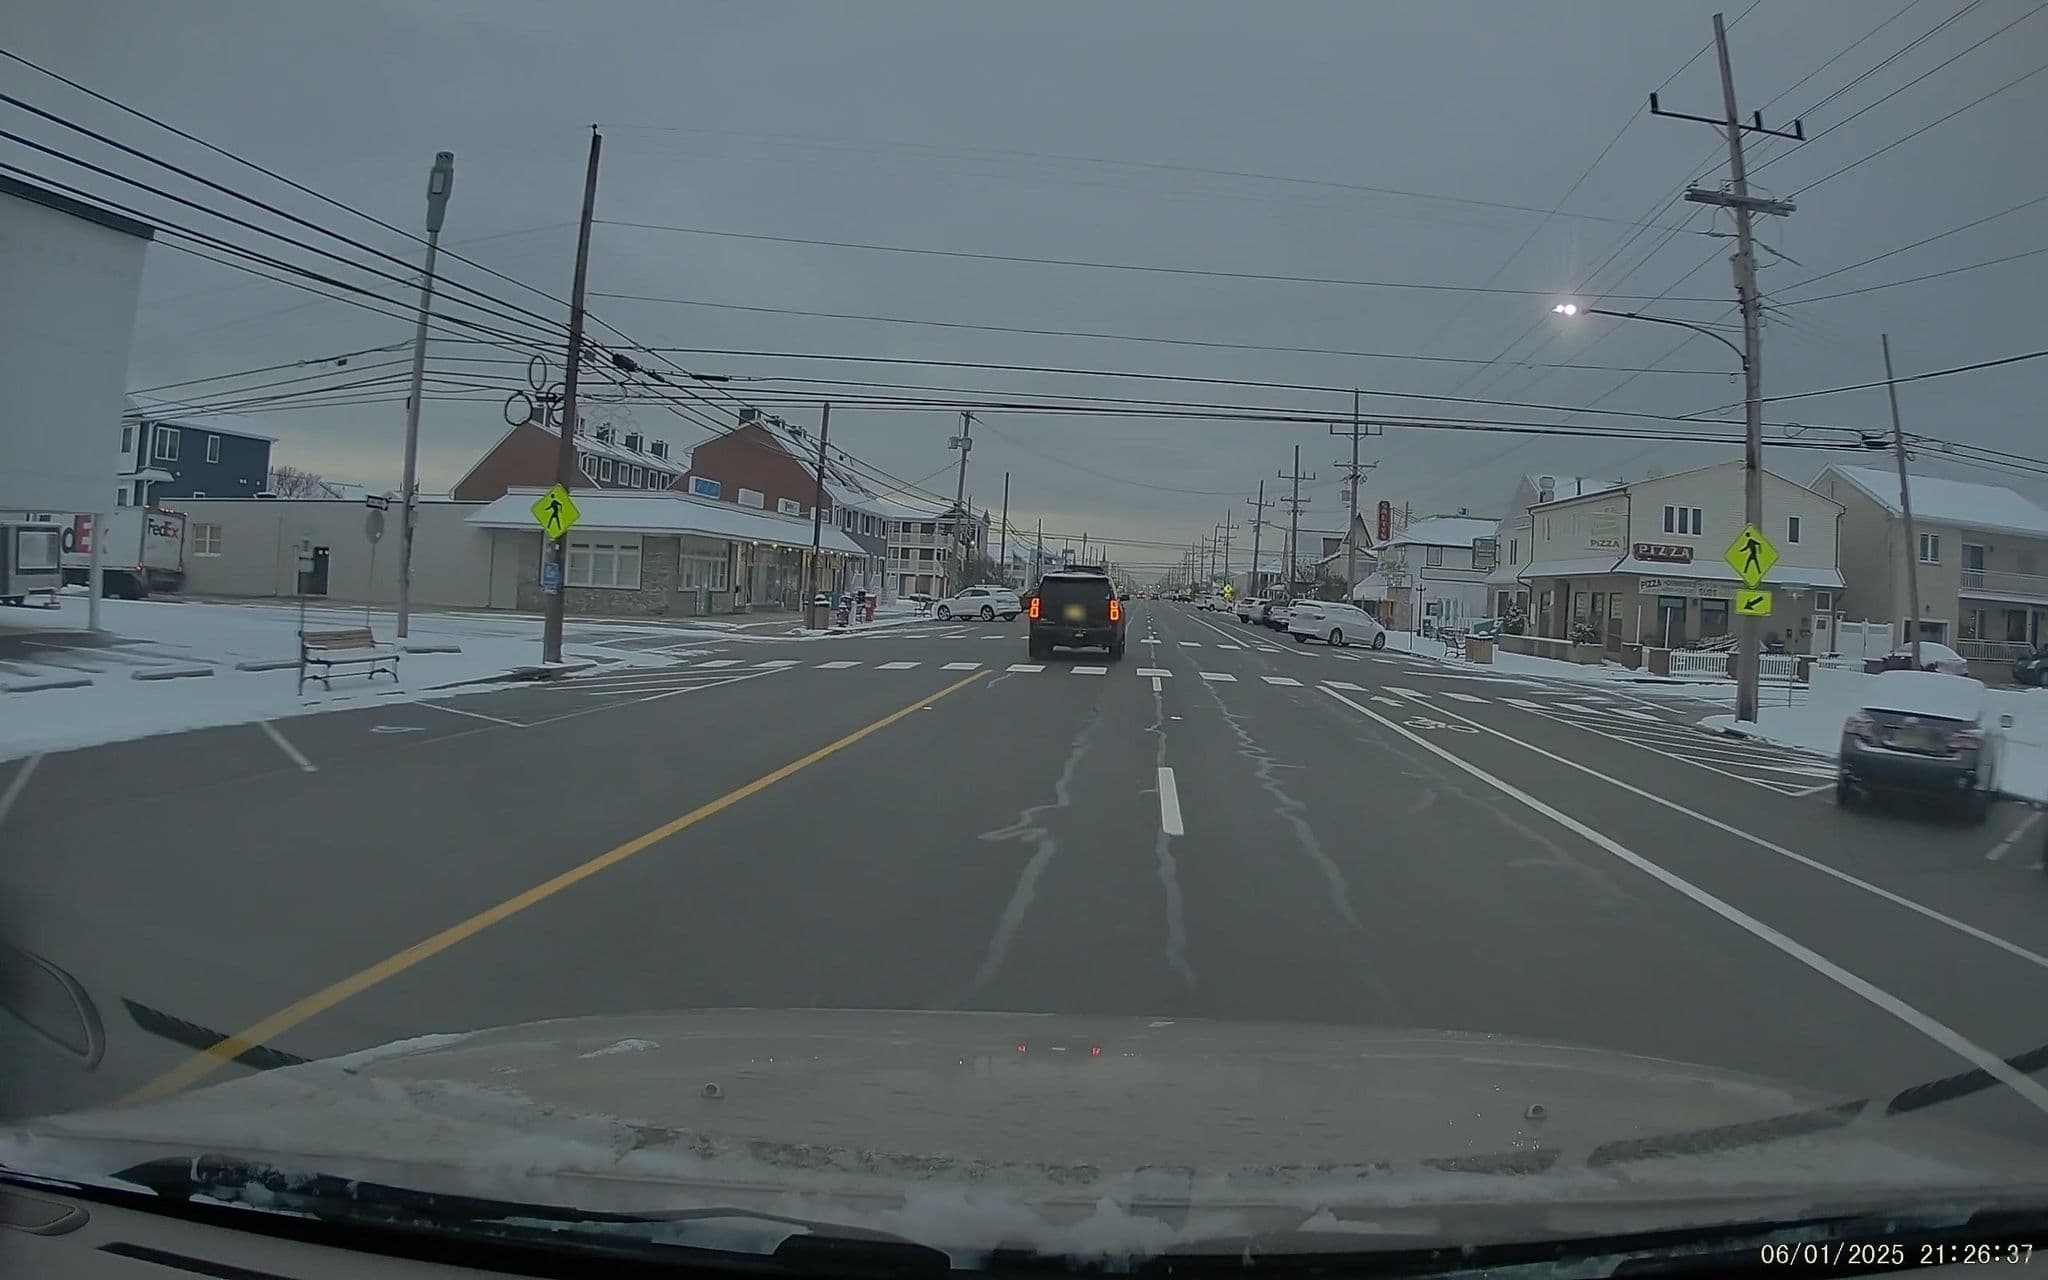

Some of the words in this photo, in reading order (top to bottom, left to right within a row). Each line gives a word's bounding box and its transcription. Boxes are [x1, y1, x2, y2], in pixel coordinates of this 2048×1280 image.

[148, 518, 179, 540] FedEx
[1590, 539, 1620, 548] PIZZA
[1639, 544, 1690, 558] PIZZA
[1641, 578, 1661, 589] PIZZA
